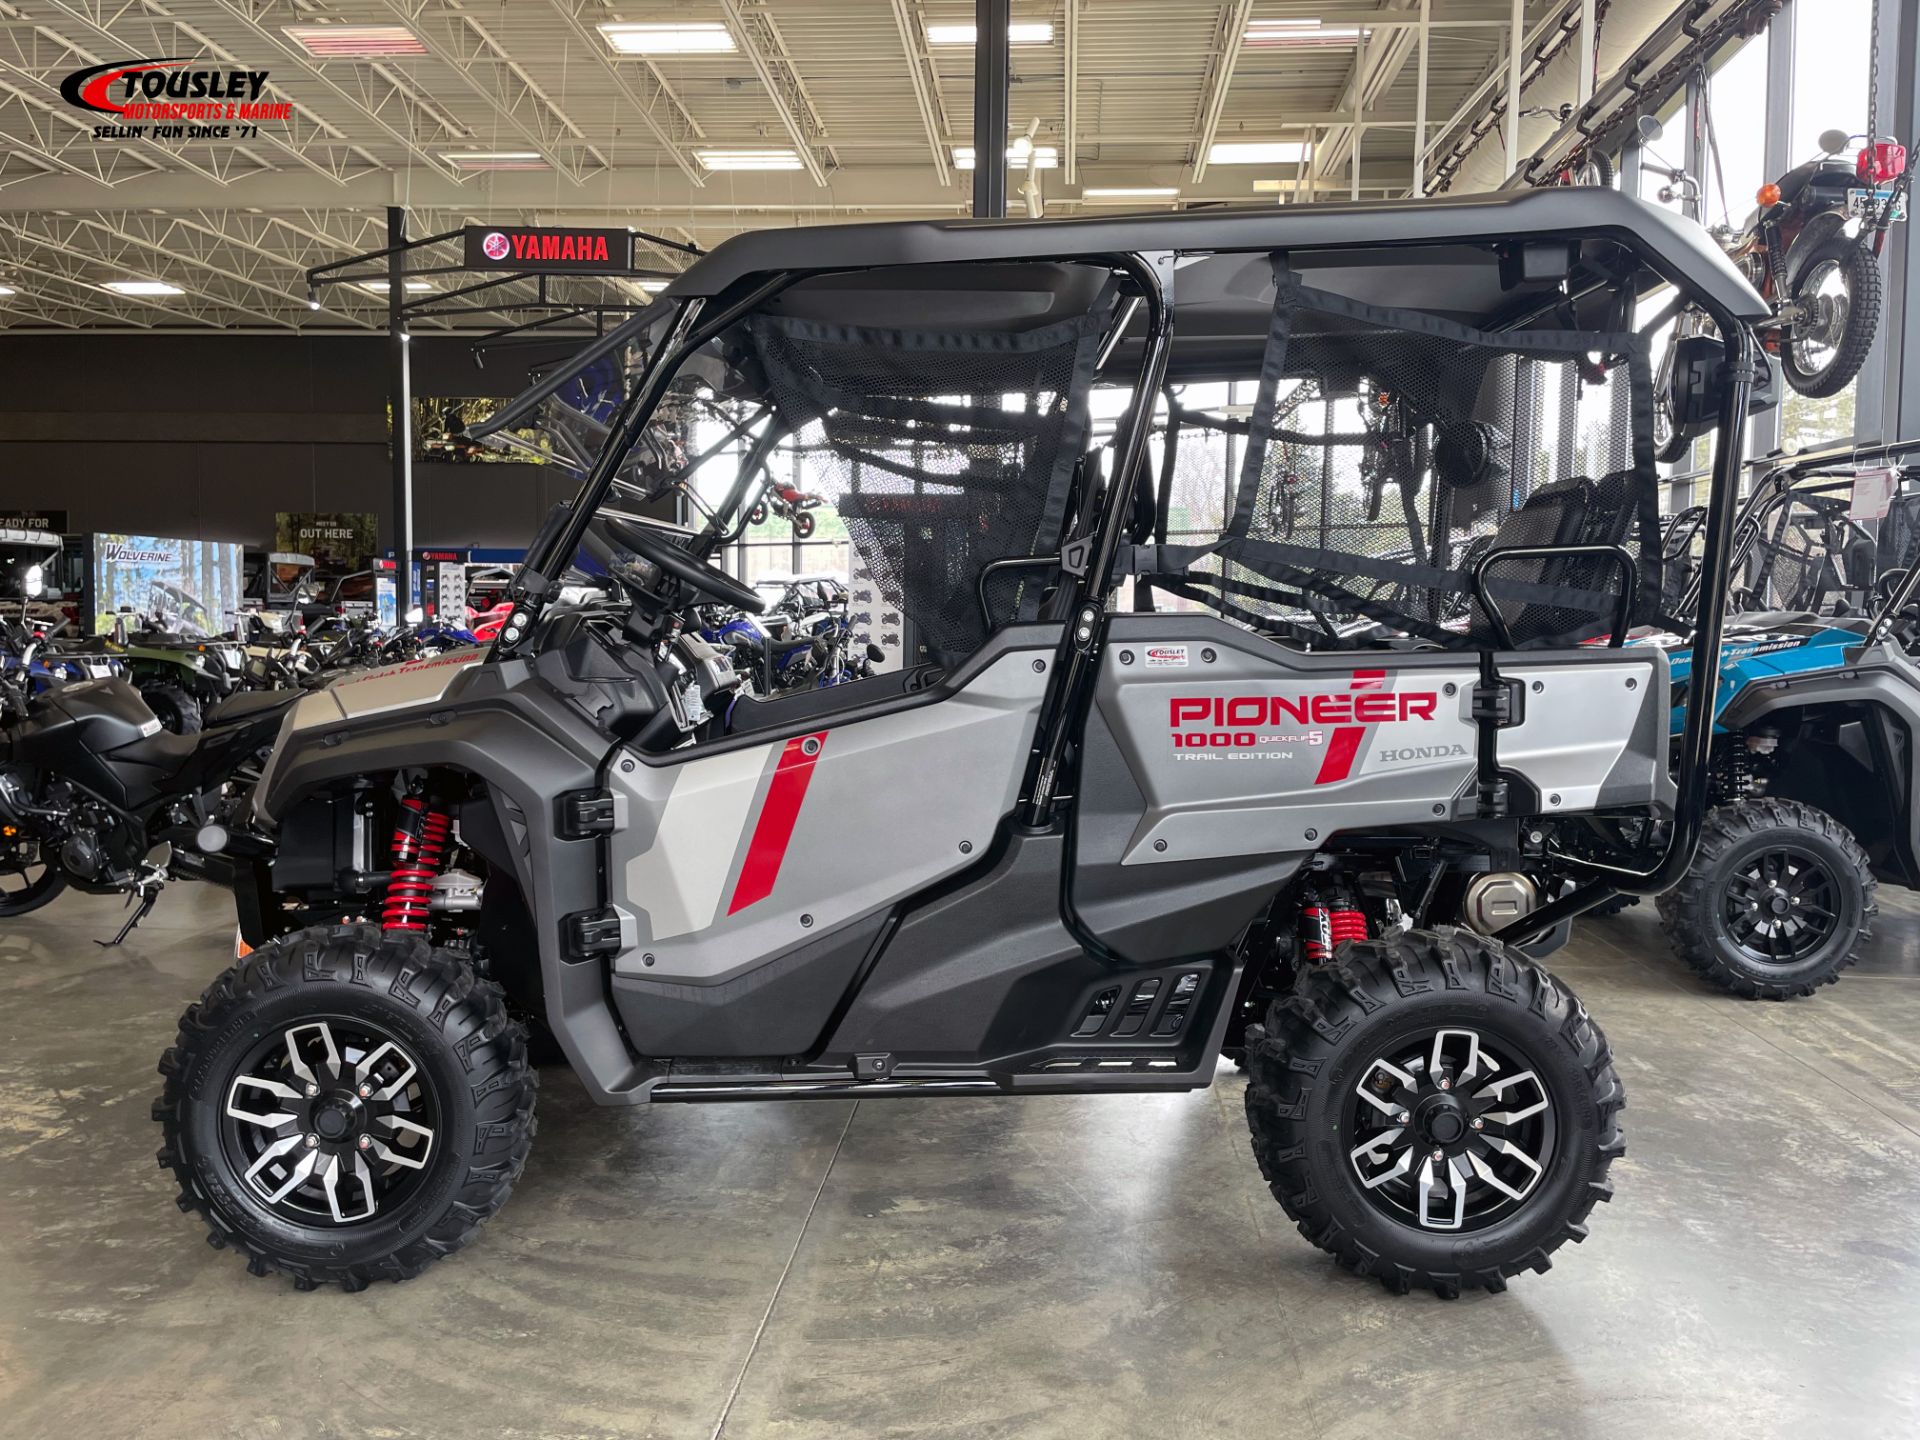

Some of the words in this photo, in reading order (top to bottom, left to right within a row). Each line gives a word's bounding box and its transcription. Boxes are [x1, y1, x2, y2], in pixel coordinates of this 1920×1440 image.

[511, 234, 609, 261] YAMAHA
[0, 518, 26, 529] EADY
[28, 518, 49, 528] FOR
[300, 528, 321, 539] OUT
[325, 528, 353, 539] HERE
[106, 543, 173, 563] WOLVERINE
[1731, 641, 1800, 656] Transmission
[1170, 692, 1437, 727] PIONEER
[1171, 732, 1256, 748] 1000
[1173, 752, 1224, 761] TRAIL
[1227, 751, 1293, 760] EDITION
[1379, 744, 1467, 762] HONDA
